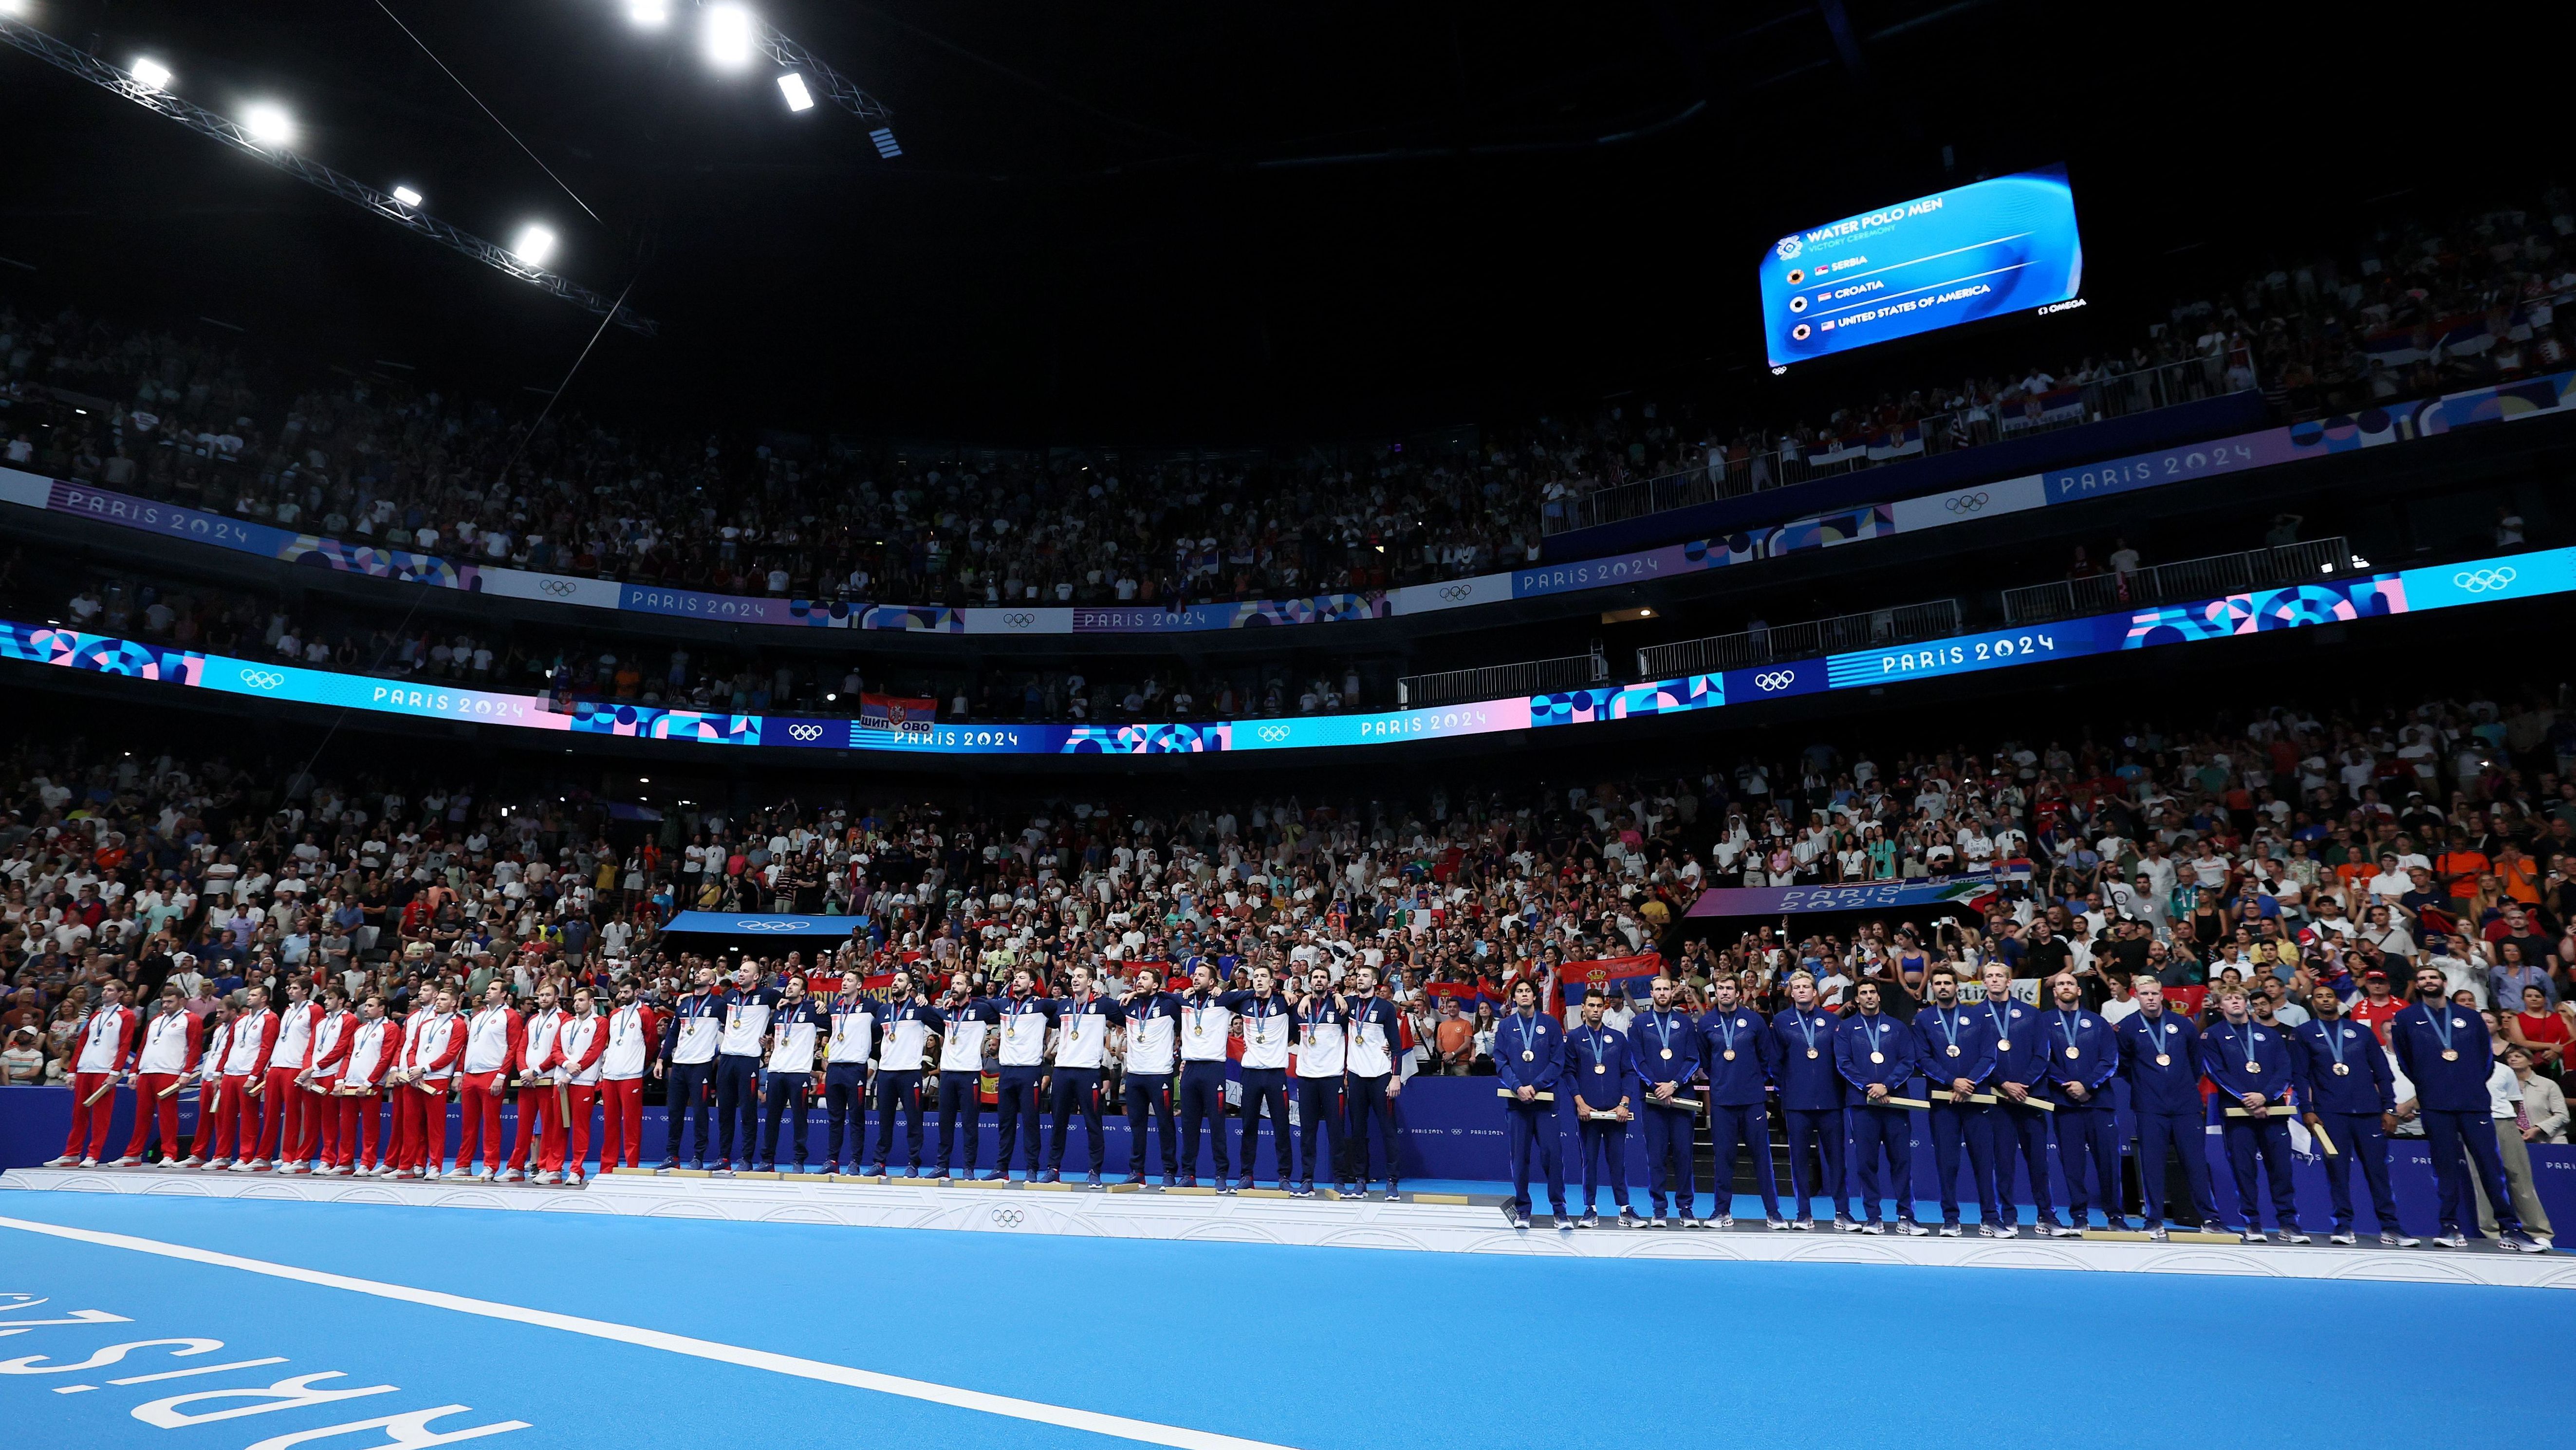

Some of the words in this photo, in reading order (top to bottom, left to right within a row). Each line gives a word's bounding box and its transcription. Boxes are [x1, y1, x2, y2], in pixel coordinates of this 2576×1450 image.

[1807, 220, 1859, 242] WATER
[1862, 208, 1905, 231] POLO
[1908, 197, 1943, 219] MEN
[1808, 237, 1846, 253] VICTORY
[1847, 224, 1896, 245] CEREMONY
[1831, 255, 1868, 272] SERBIA
[1834, 280, 1884, 299] CROATIA
[1838, 310, 1876, 328] UNITED
[1877, 300, 1916, 319] STATES
[1918, 296, 1935, 309] OF
[1936, 283, 1991, 306] AMERICA
[2049, 298, 2087, 314] OMEGA
[2061, 463, 2151, 493] PARIS
[2165, 444, 2252, 475] 2024
[67, 491, 157, 524] PARIS
[170, 514, 248, 544] 2024
[1524, 569, 1589, 591] PARIS
[1599, 558, 1658, 580] 2024
[632, 592, 698, 613] PARIS
[707, 600, 765, 617] 2024
[1085, 613, 1144, 627] PARIS
[1153, 612, 1205, 627] 2024
[1883, 646, 1964, 674] PARIS
[1976, 633, 2054, 660] 2024
[373, 688, 449, 710] PARIS
[457, 698, 524, 719] 2024
[861, 716, 890, 729] ШИП
[1361, 717, 1422, 737] PARIS
[1430, 710, 1486, 731] 2024
[894, 731, 955, 746] PARIS
[964, 731, 1018, 746] 2024
[1778, 897, 1896, 911] 2024
[1783, 886, 1899, 901] PARIS
[2545, 1162, 2576, 1170] PARI
